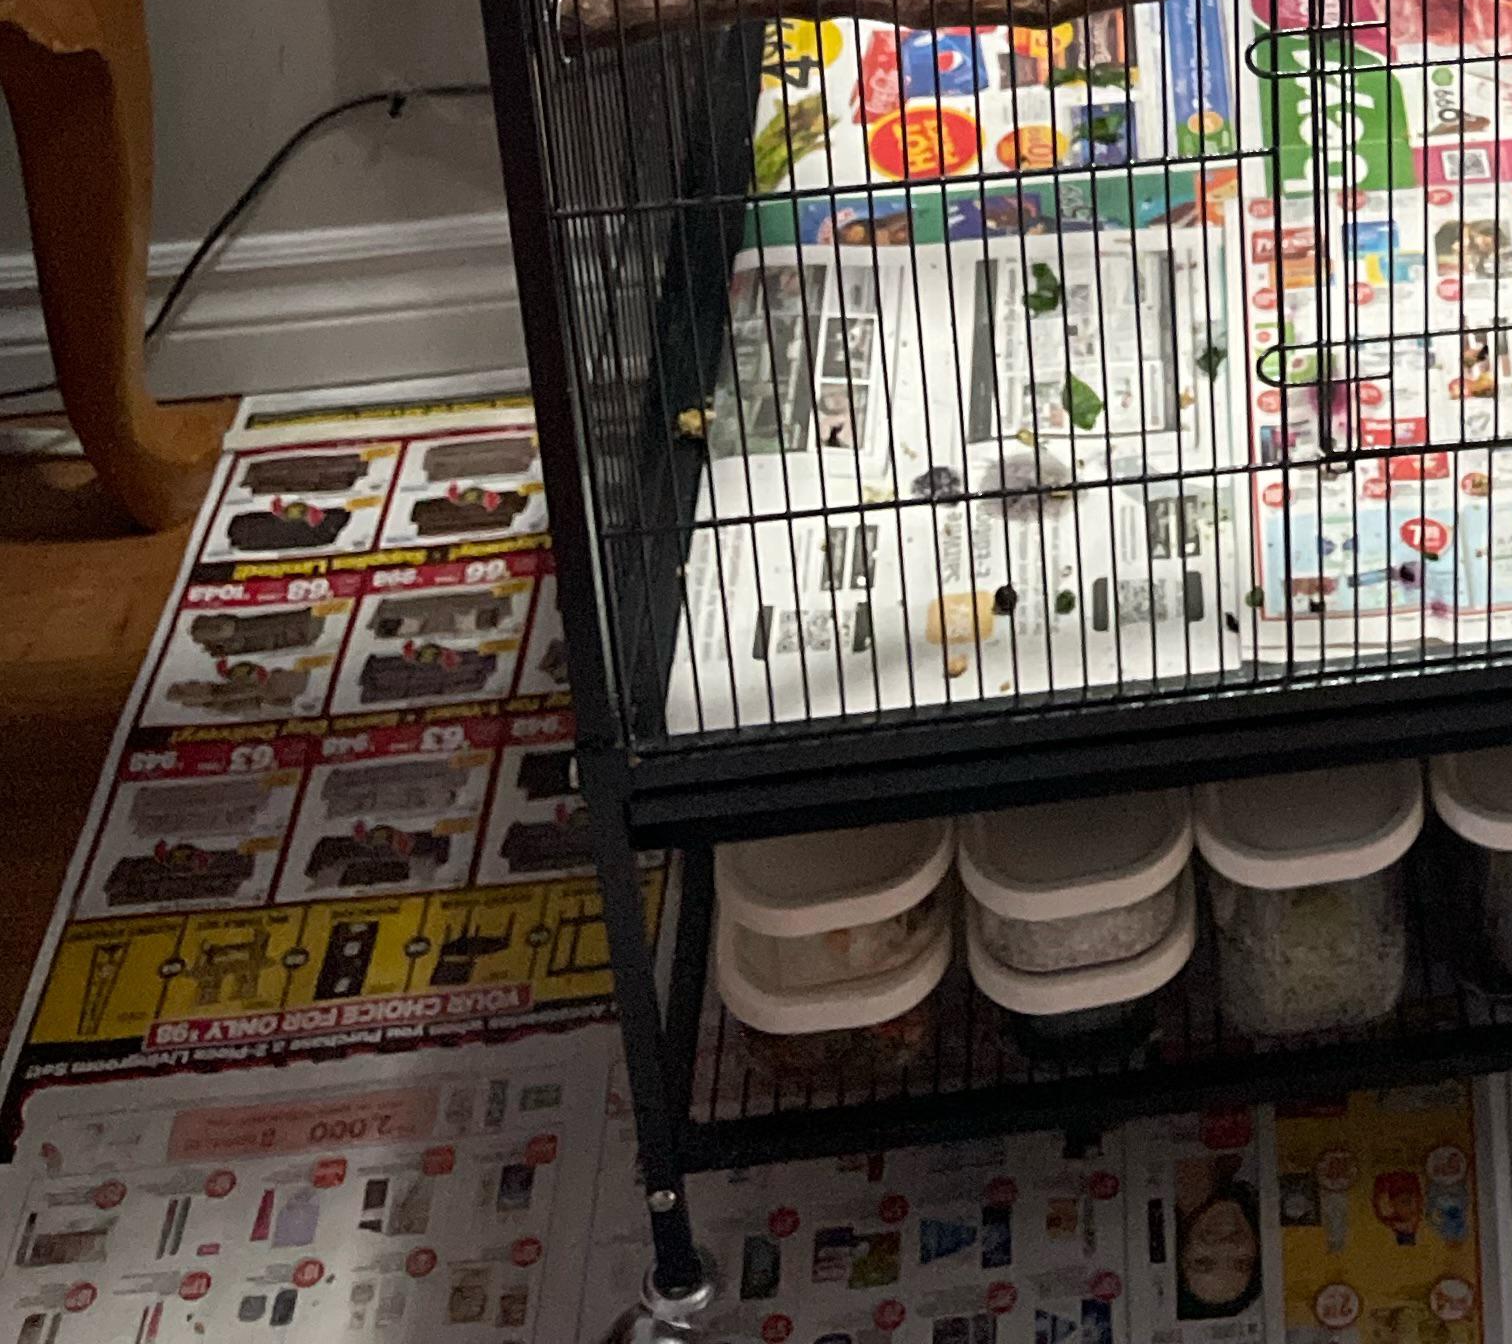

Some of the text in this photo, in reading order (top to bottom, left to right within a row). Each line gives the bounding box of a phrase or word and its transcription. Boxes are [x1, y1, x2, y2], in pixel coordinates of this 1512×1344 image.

[282, 1006, 338, 1032] FOR
[342, 995, 441, 1028] CHOICE
[209, 1014, 277, 1038] ONLY
[289, 1030, 382, 1050] Purchase
